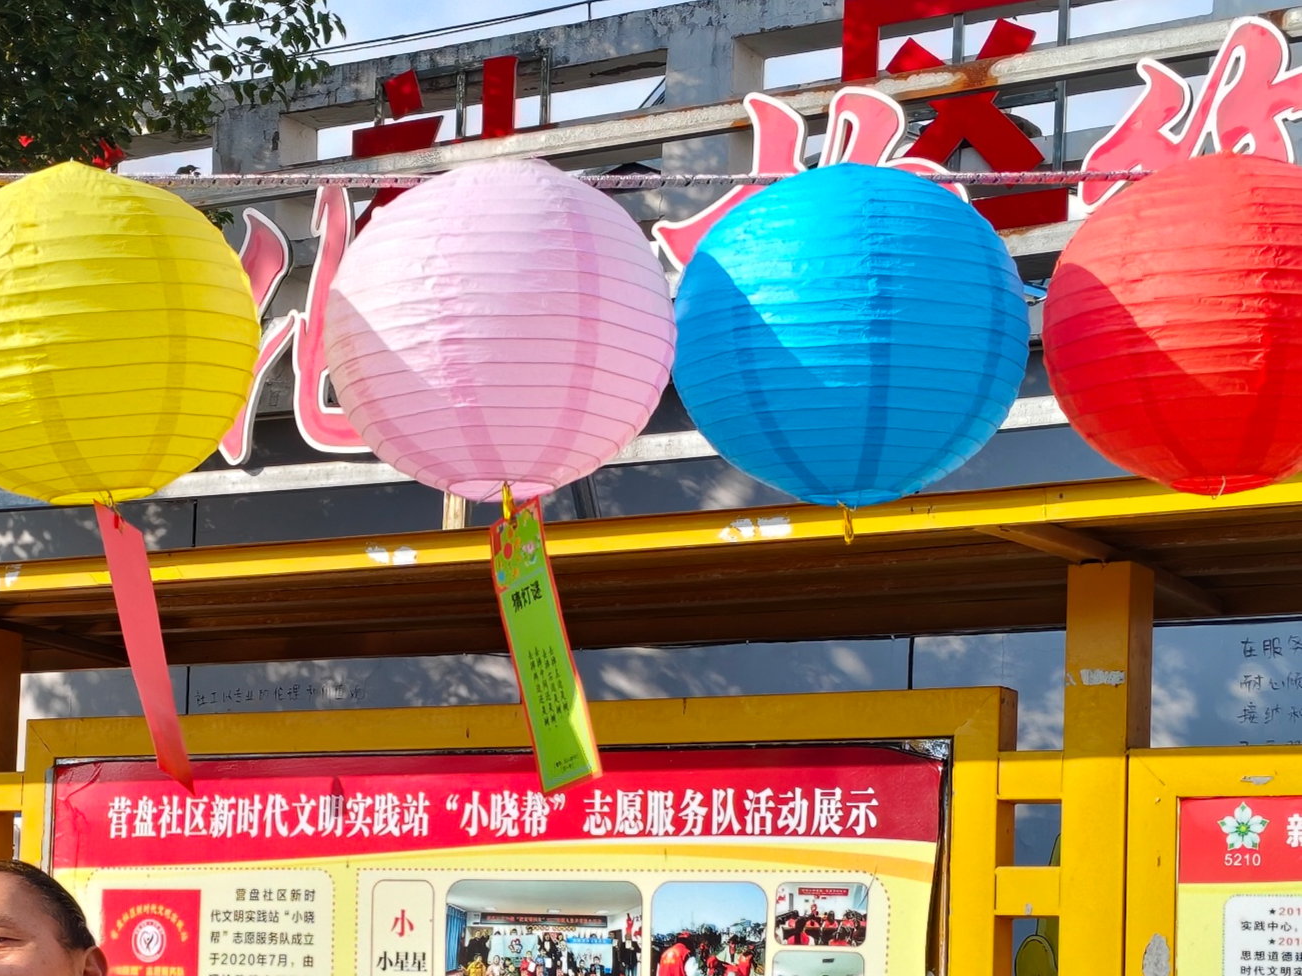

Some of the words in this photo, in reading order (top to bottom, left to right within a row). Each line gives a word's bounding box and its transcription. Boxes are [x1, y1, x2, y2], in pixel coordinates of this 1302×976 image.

[511, 580, 543, 613] 猜灯谜
[108, 787, 880, 839] 营盘社区新时代文明实践站“小晓帮”志愿服务队活动展示
[1224, 853, 1261, 866] 5210
[235, 888, 316, 902] 营盘社区新时
[210, 909, 315, 924] 代文明实践站“小晓
[391, 908, 415, 938] 小
[1240, 920, 1298, 932] 实践中心，
[209, 930, 315, 946] 帮”志愿服务队成立
[1278, 937, 1302, 946] 201
[209, 952, 314, 968] 于2020年7月，由
[376, 950, 428, 973] 小星星
